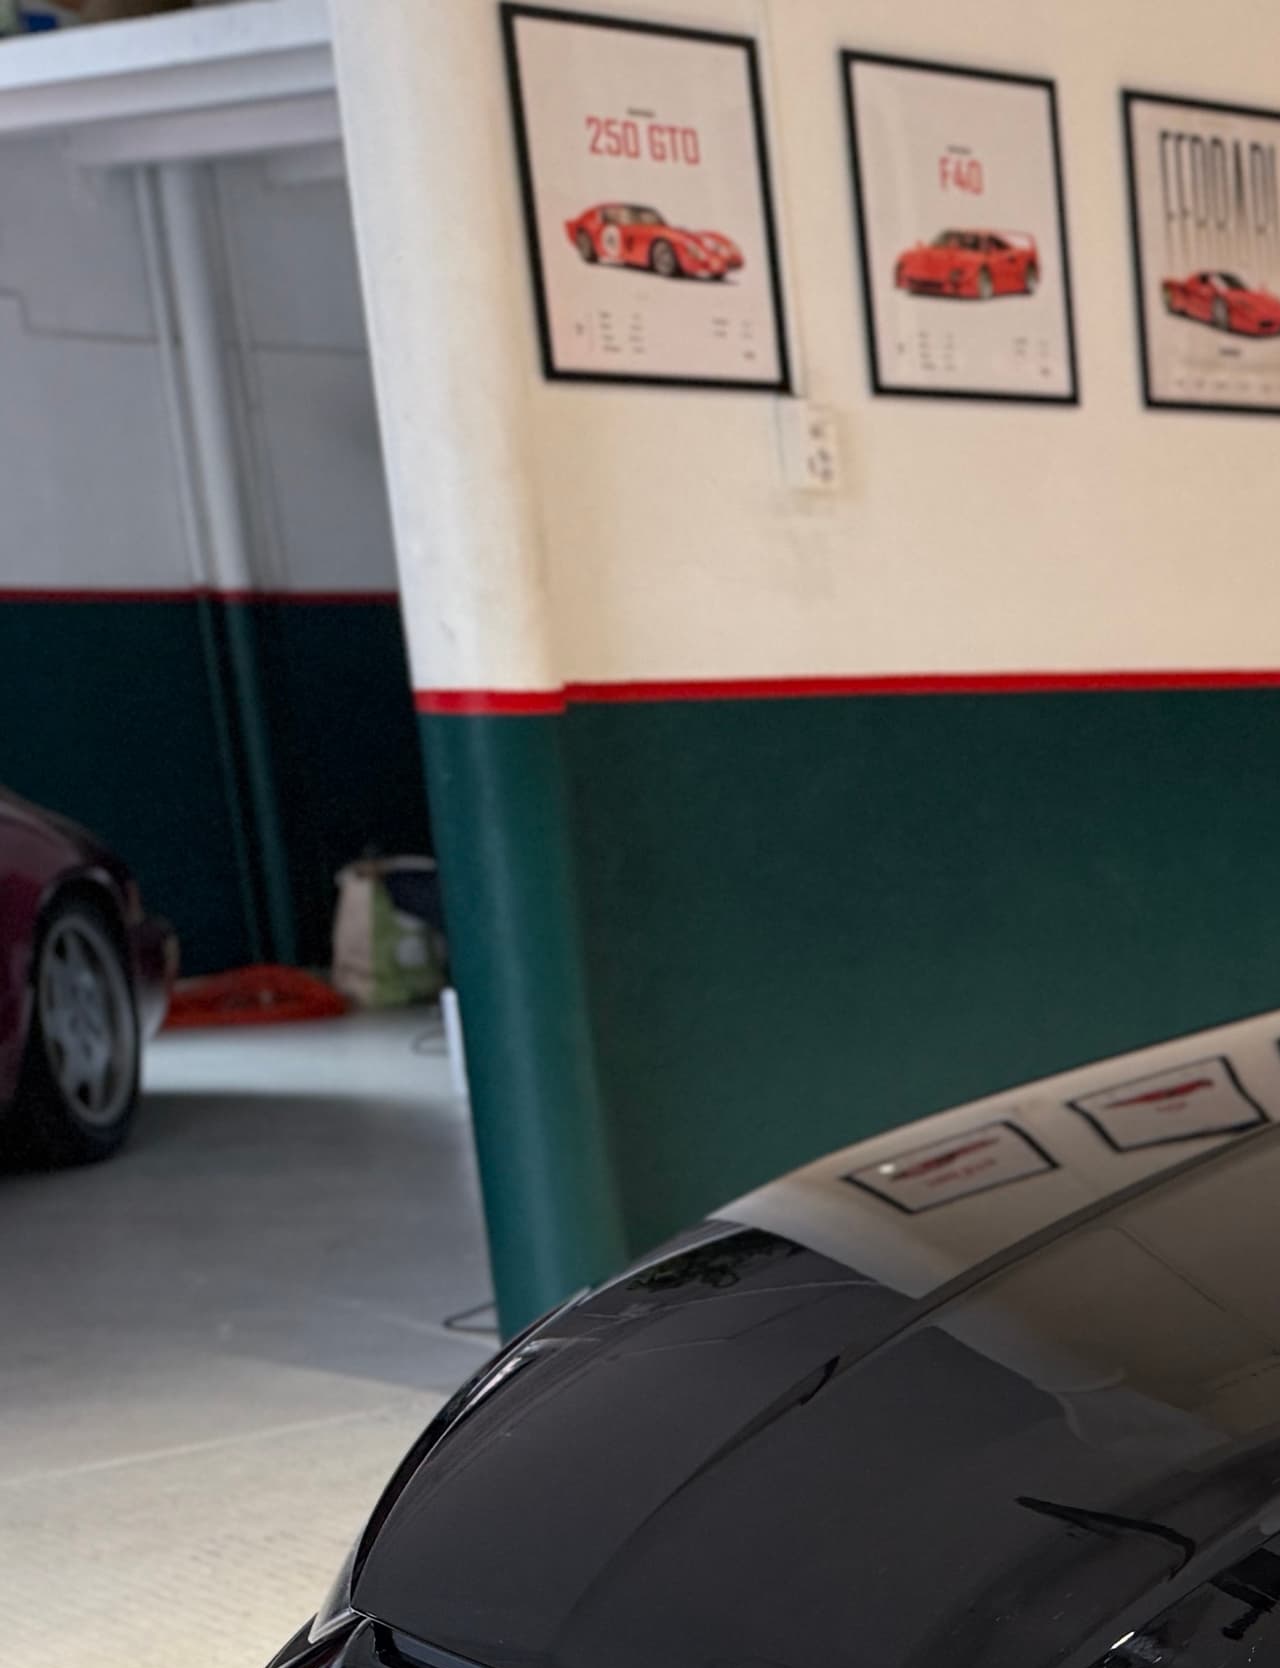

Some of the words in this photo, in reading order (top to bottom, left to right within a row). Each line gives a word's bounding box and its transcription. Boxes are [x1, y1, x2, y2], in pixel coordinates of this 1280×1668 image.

[585, 116, 640, 159] 250
[647, 122, 701, 165] GTO
[939, 156, 984, 196] F40
